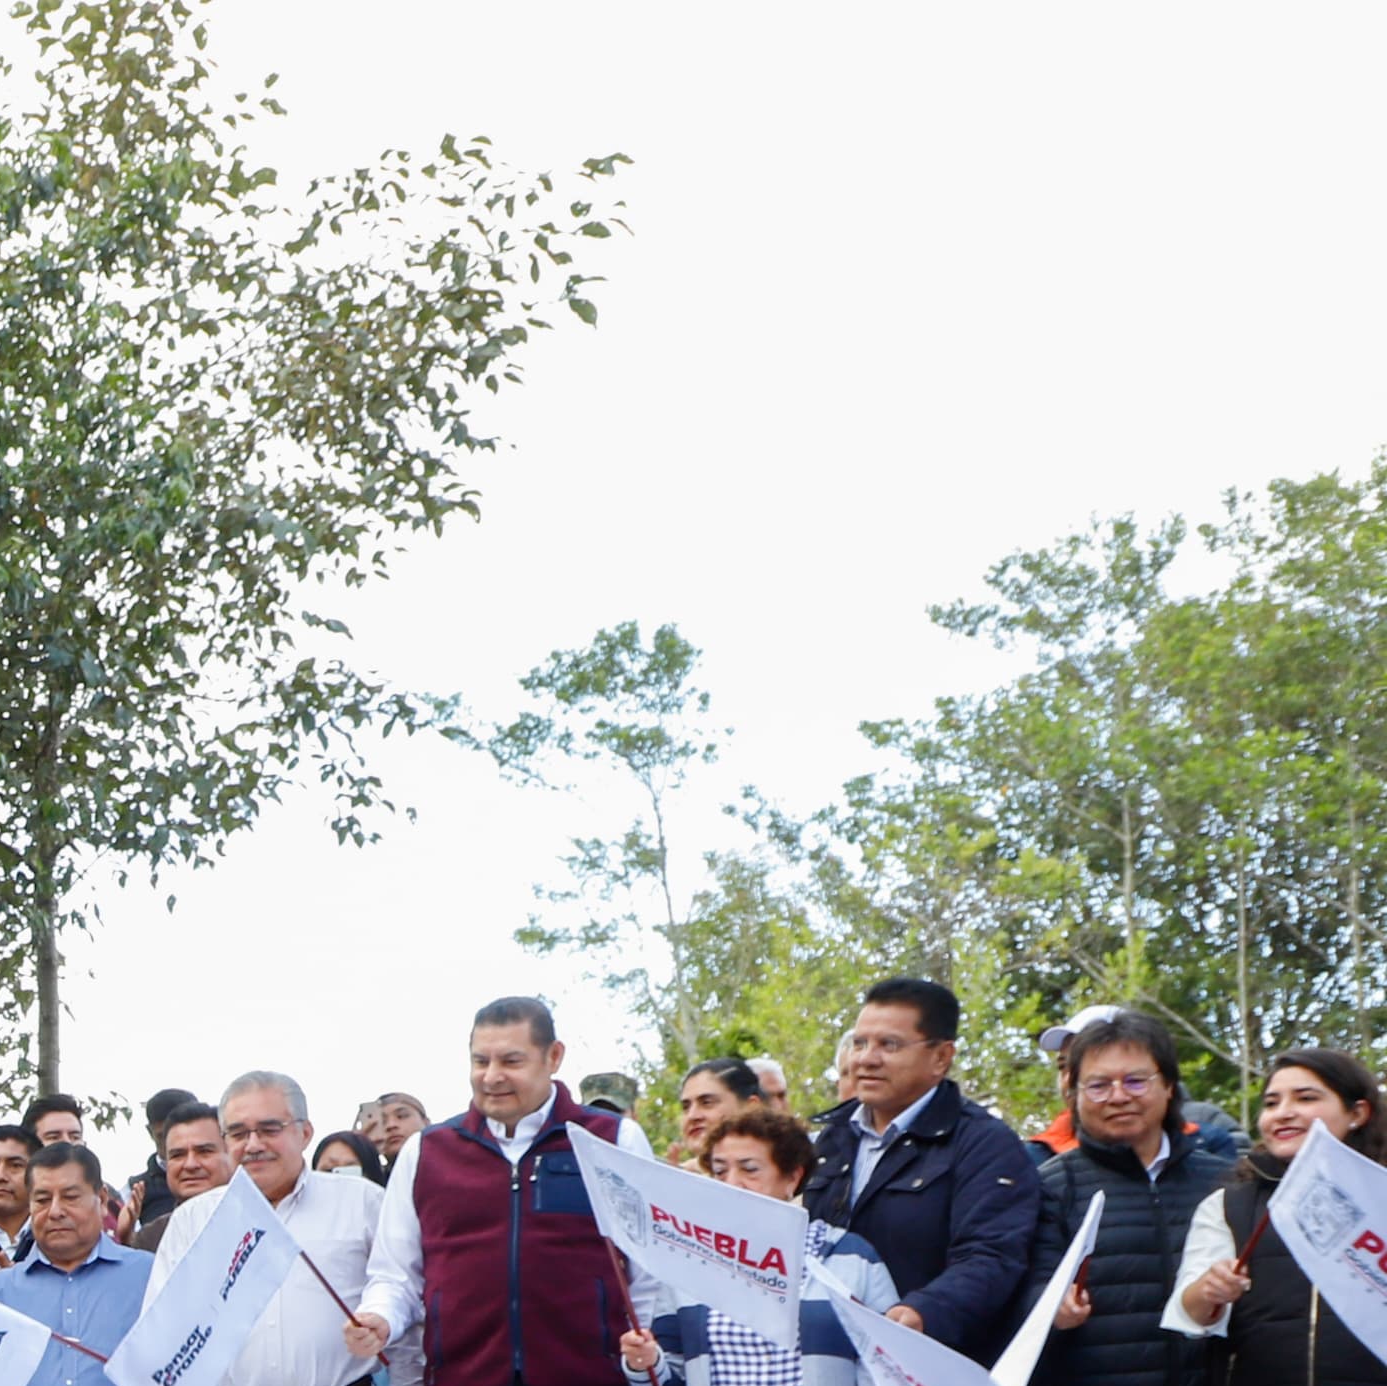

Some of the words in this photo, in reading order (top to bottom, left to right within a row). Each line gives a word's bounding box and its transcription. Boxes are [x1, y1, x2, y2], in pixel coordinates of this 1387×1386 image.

[222, 1228, 267, 1301] PUEBLA
[650, 1203, 788, 1277] PUEBLA
[735, 1263, 788, 1290] Estado
[151, 1324, 201, 1385] Pensar
